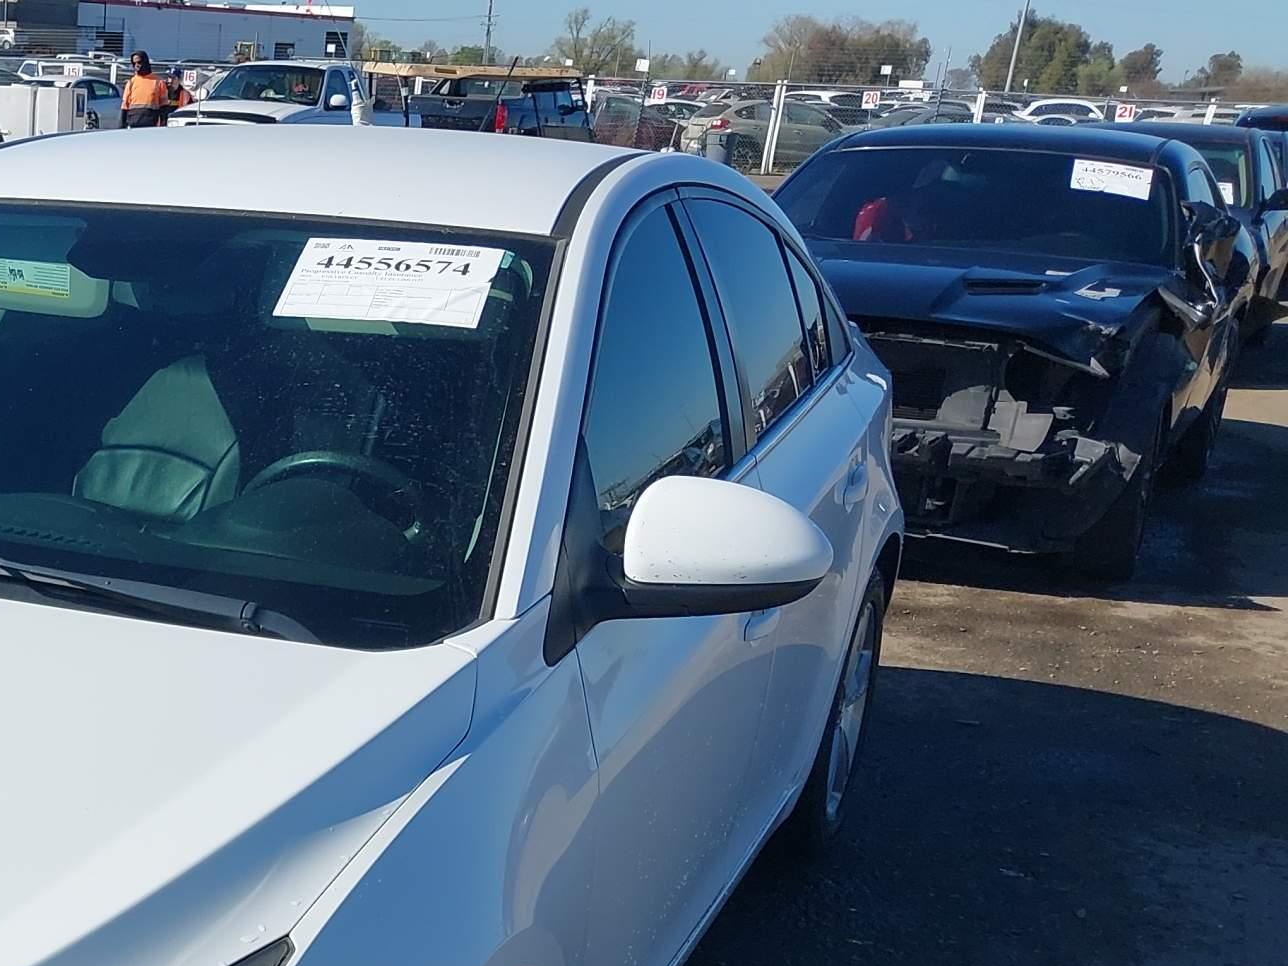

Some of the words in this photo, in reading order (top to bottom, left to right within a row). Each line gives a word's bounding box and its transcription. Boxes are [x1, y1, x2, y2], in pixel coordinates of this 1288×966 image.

[184, 71, 195, 82] 16
[652, 88, 665, 100] 19
[864, 92, 878, 104] 20
[1117, 106, 1133, 118] 21
[1081, 166, 1142, 180] 44579566
[315, 254, 472, 276] 44556574
